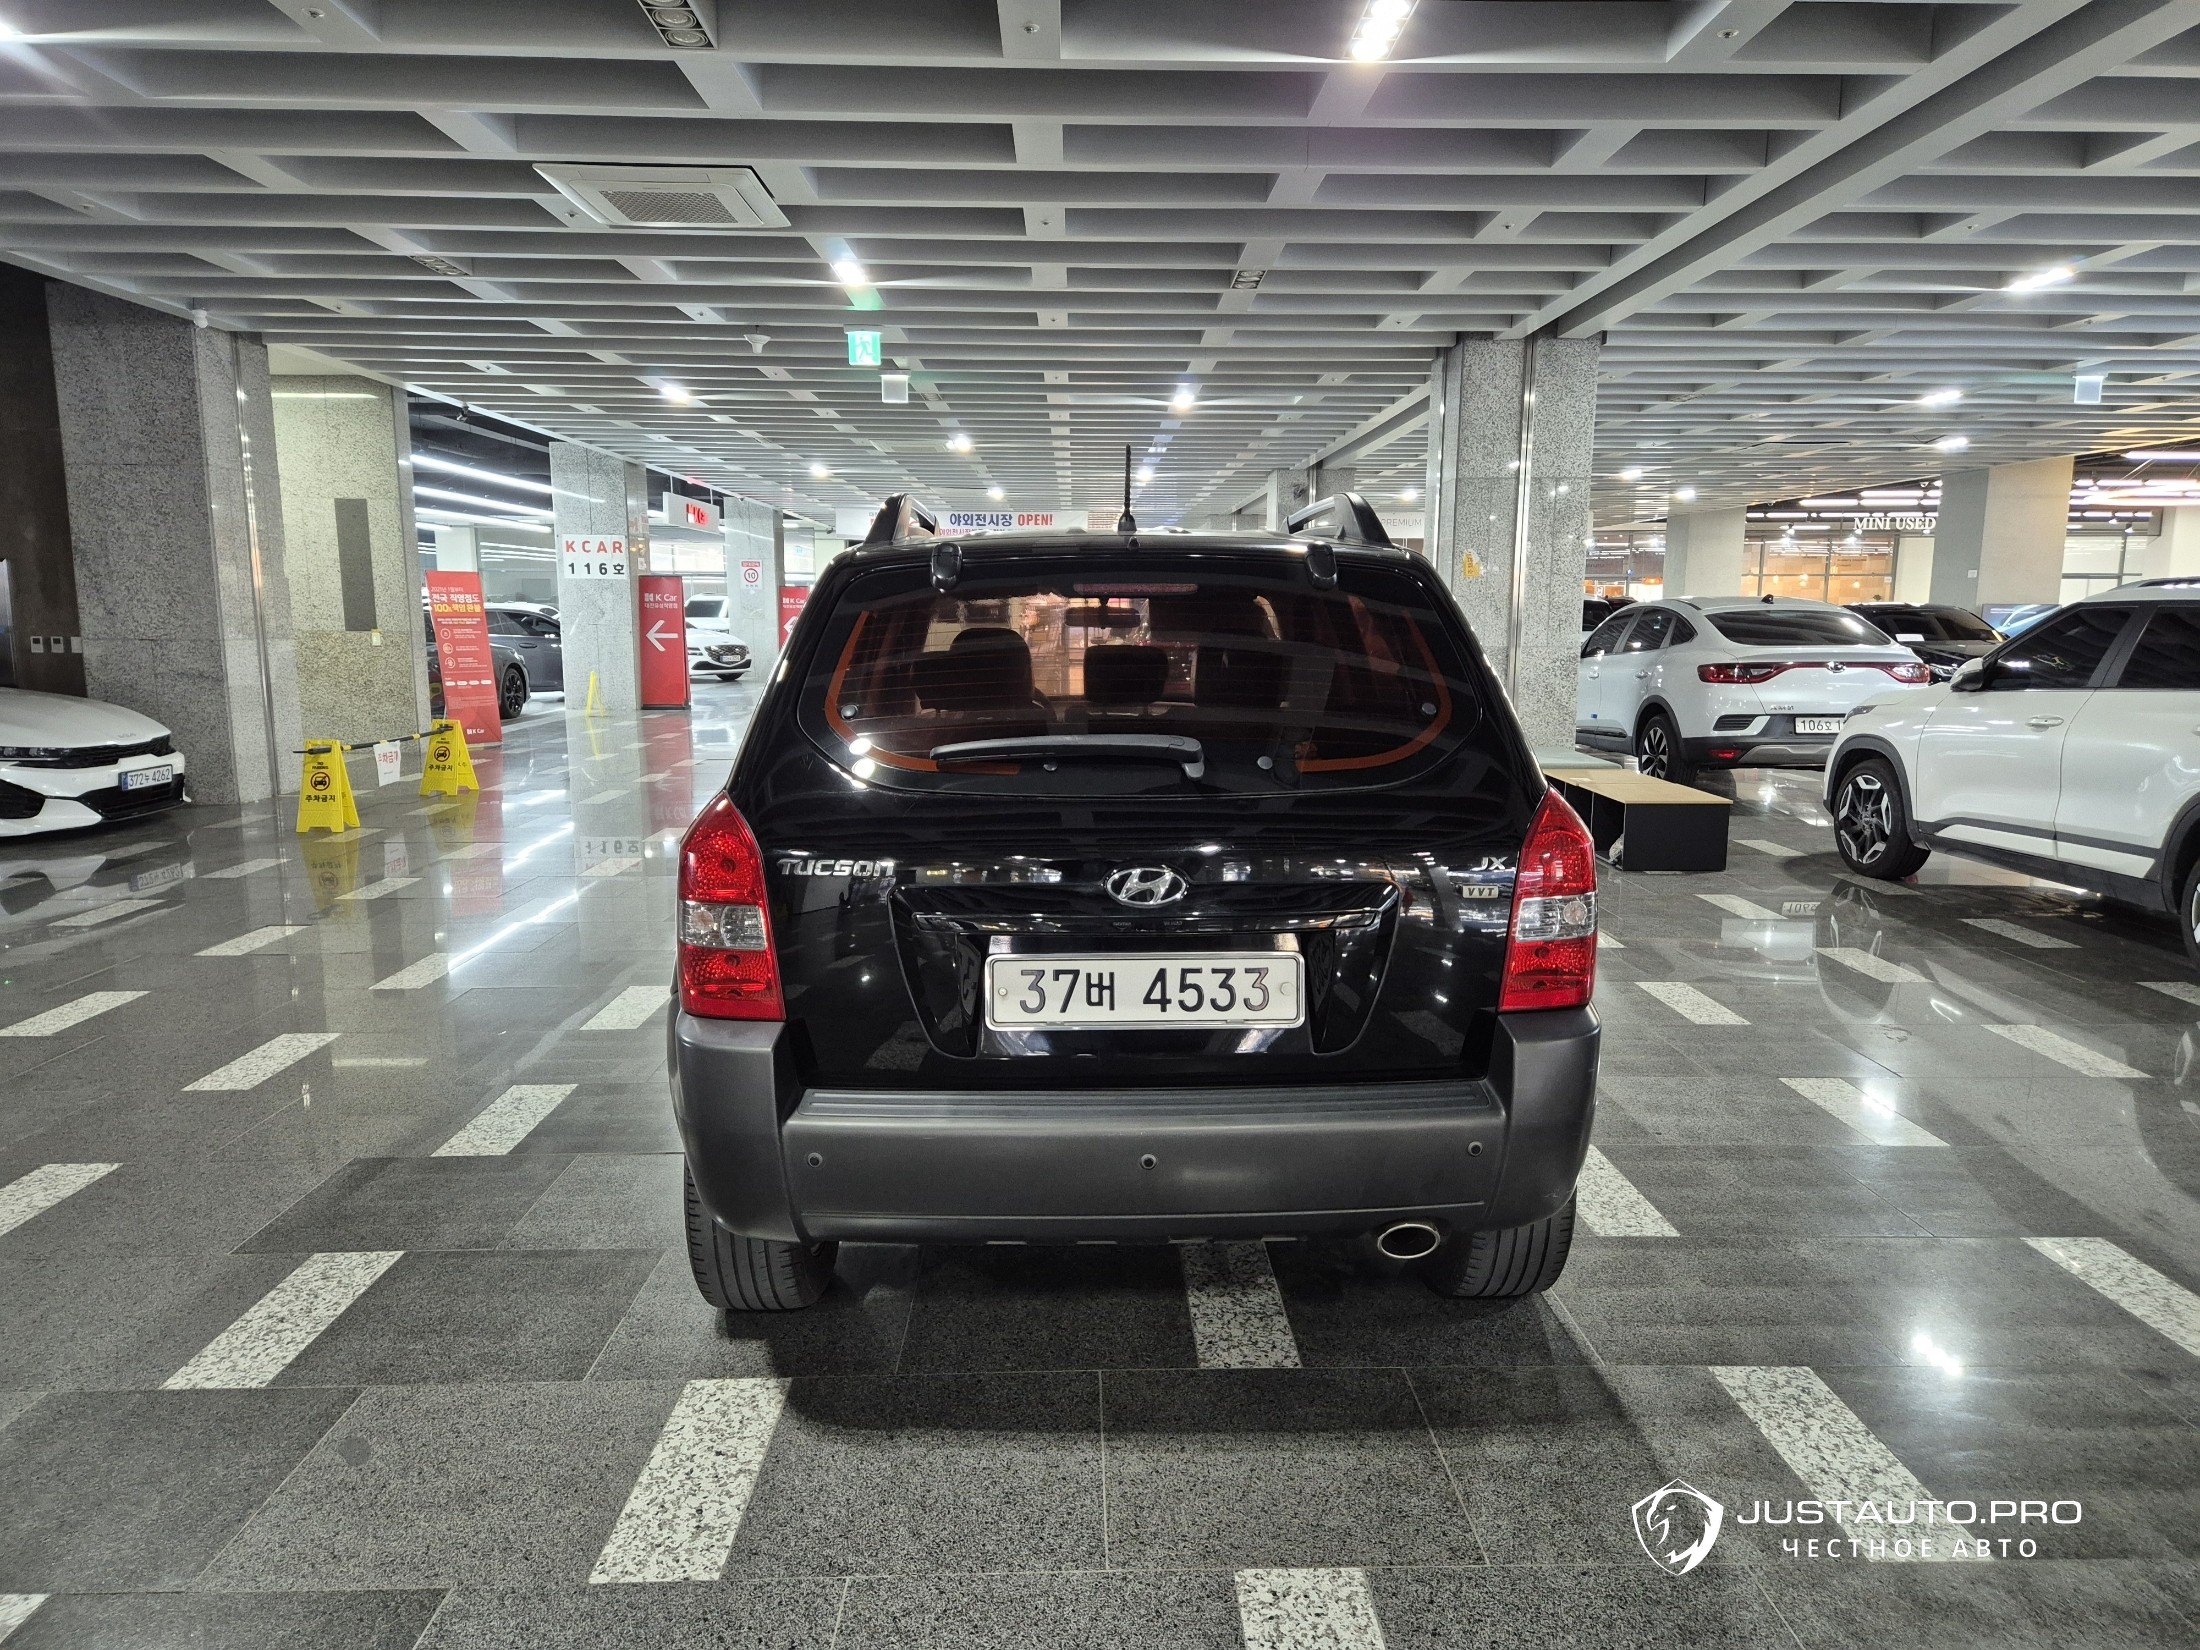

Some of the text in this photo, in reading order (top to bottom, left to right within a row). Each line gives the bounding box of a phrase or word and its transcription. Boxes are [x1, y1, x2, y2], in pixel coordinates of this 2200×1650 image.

[949, 513, 1053, 527] 야외전시장 OPEN!
[1853, 517, 1937, 530] MINI USED
[568, 562, 625, 575] 116호
[747, 572, 756, 580] 10
[431, 593, 448, 603] 전국
[655, 593, 678, 601] K Car
[1801, 719, 1832, 731] 106호
[152, 768, 171, 782] 4262
[305, 794, 336, 803] 주차금지
[777, 858, 895, 877] TUCSON
[1470, 856, 1508, 871] JX
[1467, 887, 1495, 897] VVT
[1019, 967, 1271, 1014] 37버 4533
